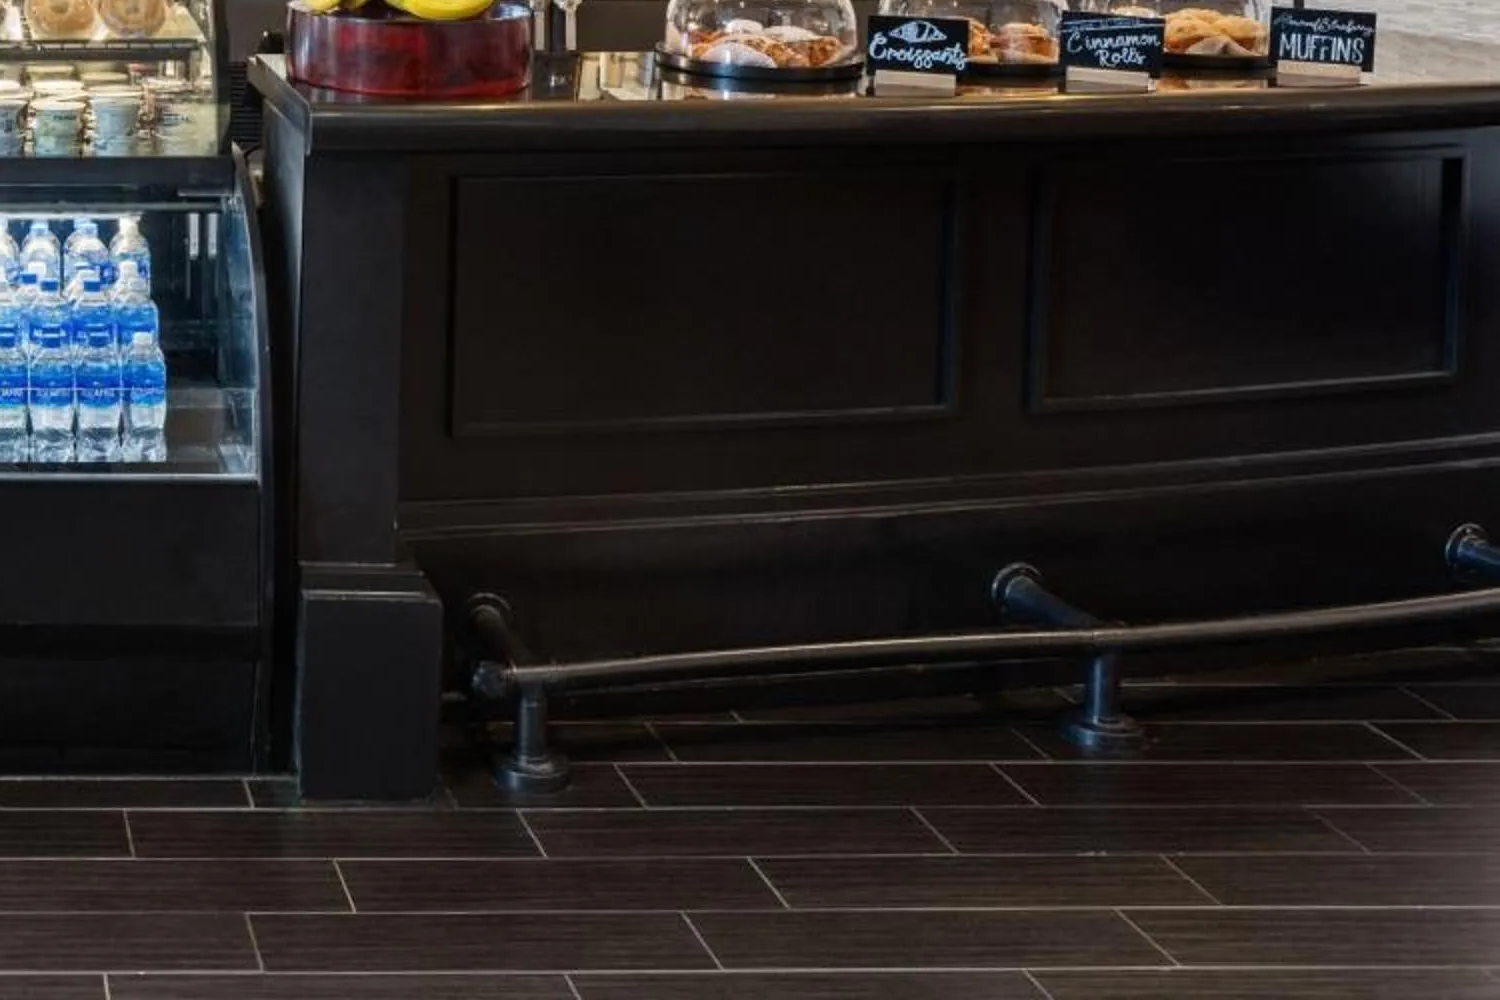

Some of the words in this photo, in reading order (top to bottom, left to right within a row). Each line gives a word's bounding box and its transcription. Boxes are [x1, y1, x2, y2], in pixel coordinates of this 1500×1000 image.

[869, 32, 967, 70] Croissants
[1067, 31, 1161, 53] Cinnamon
[1280, 32, 1365, 63] MUFFINS
[1094, 47, 1146, 68] Rolls
